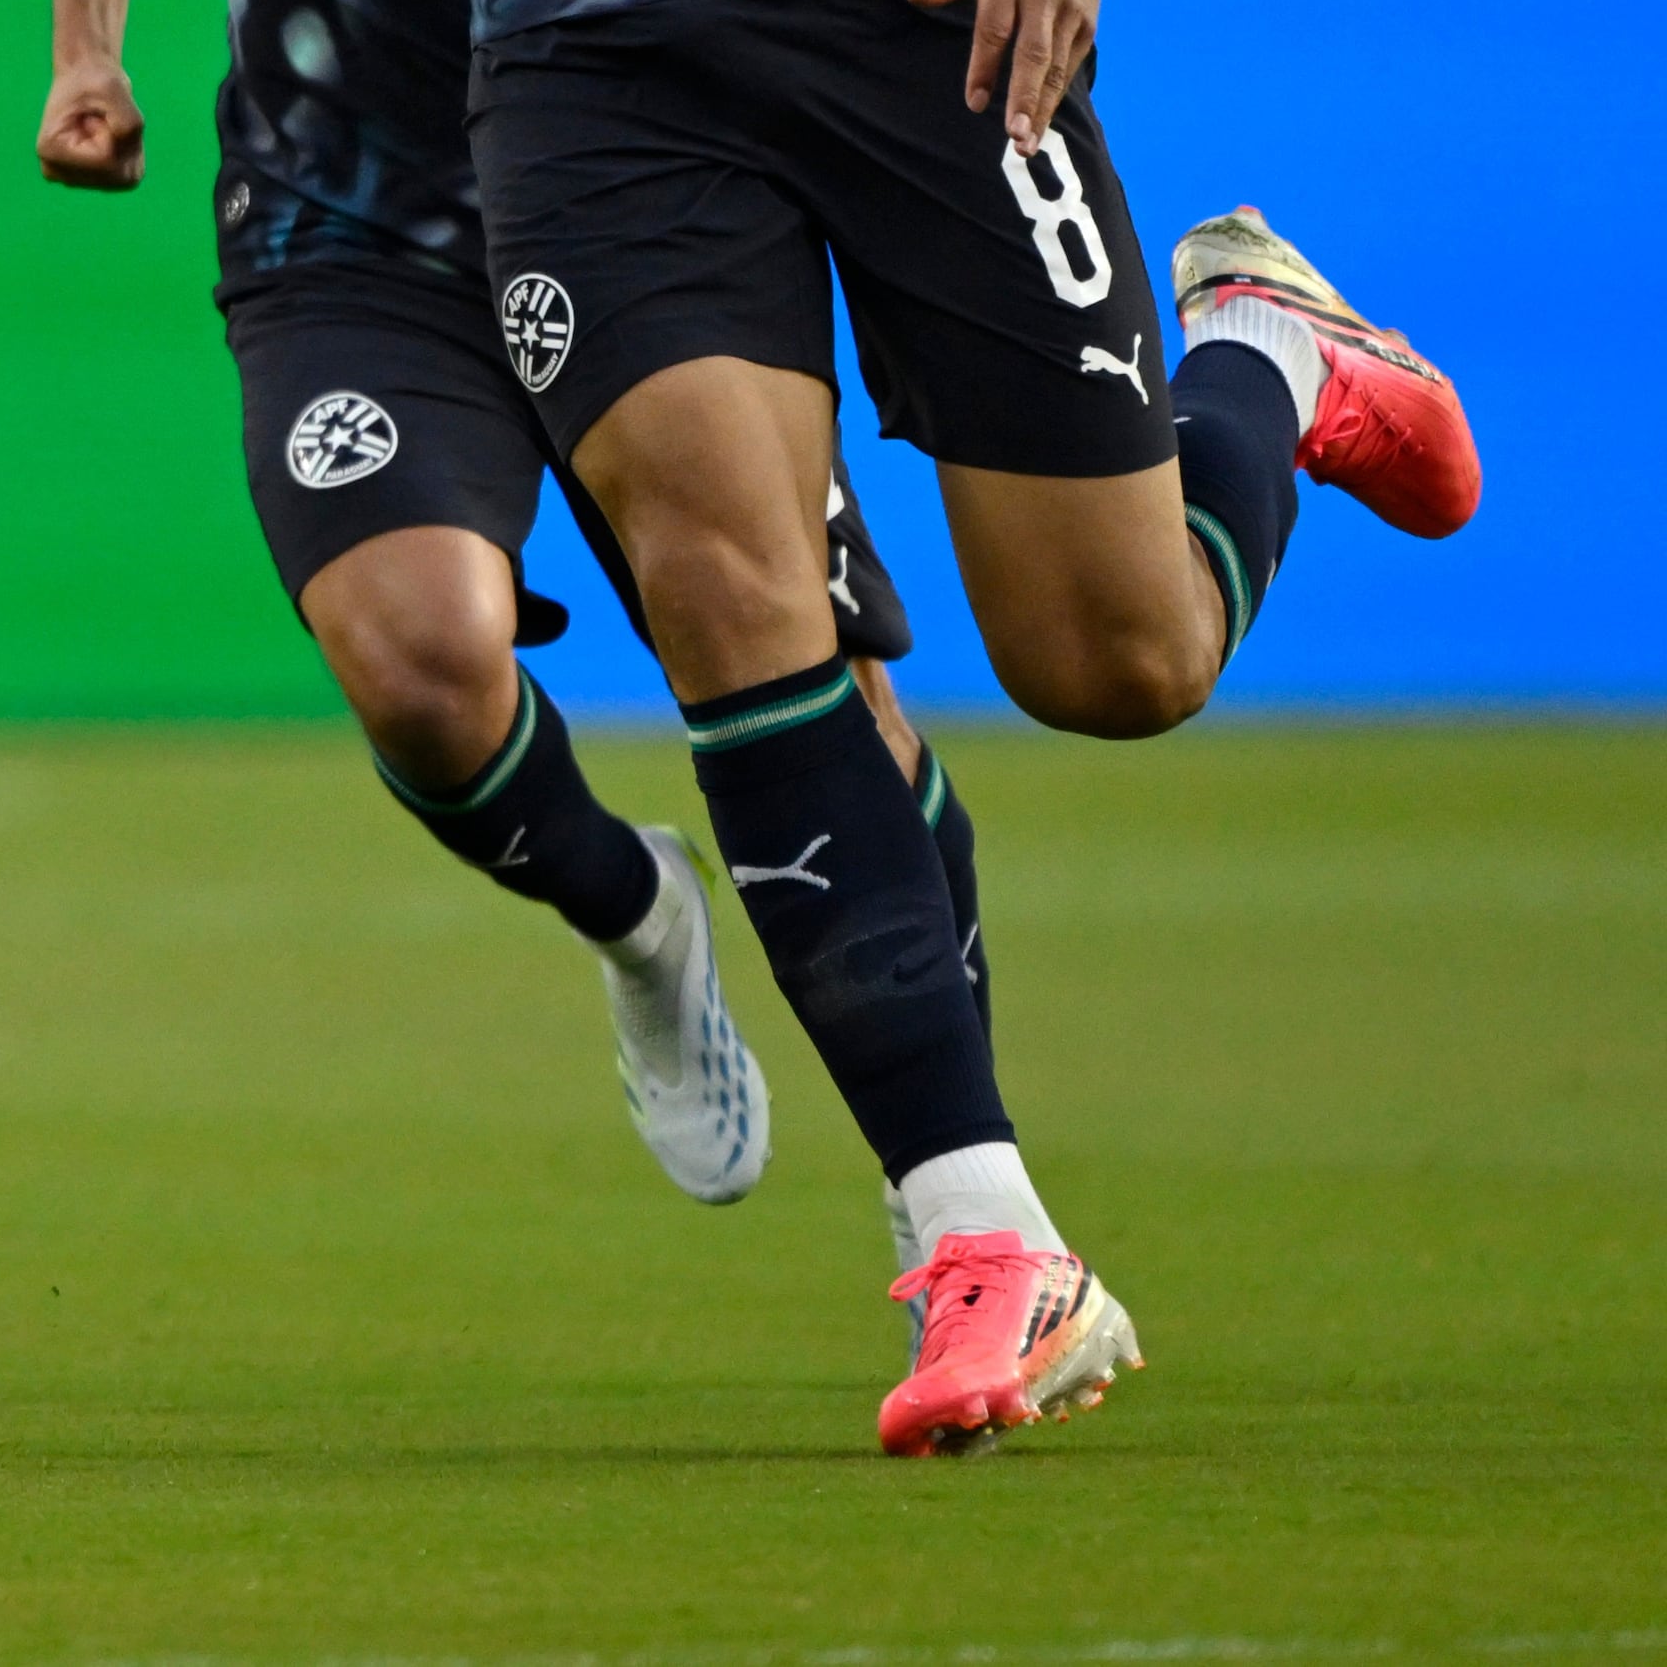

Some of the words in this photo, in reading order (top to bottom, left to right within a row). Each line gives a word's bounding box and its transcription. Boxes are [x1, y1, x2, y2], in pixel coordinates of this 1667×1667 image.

[1001, 125, 1113, 309] 8
[508, 282, 529, 317] APF
[314, 399, 349, 425] APF
